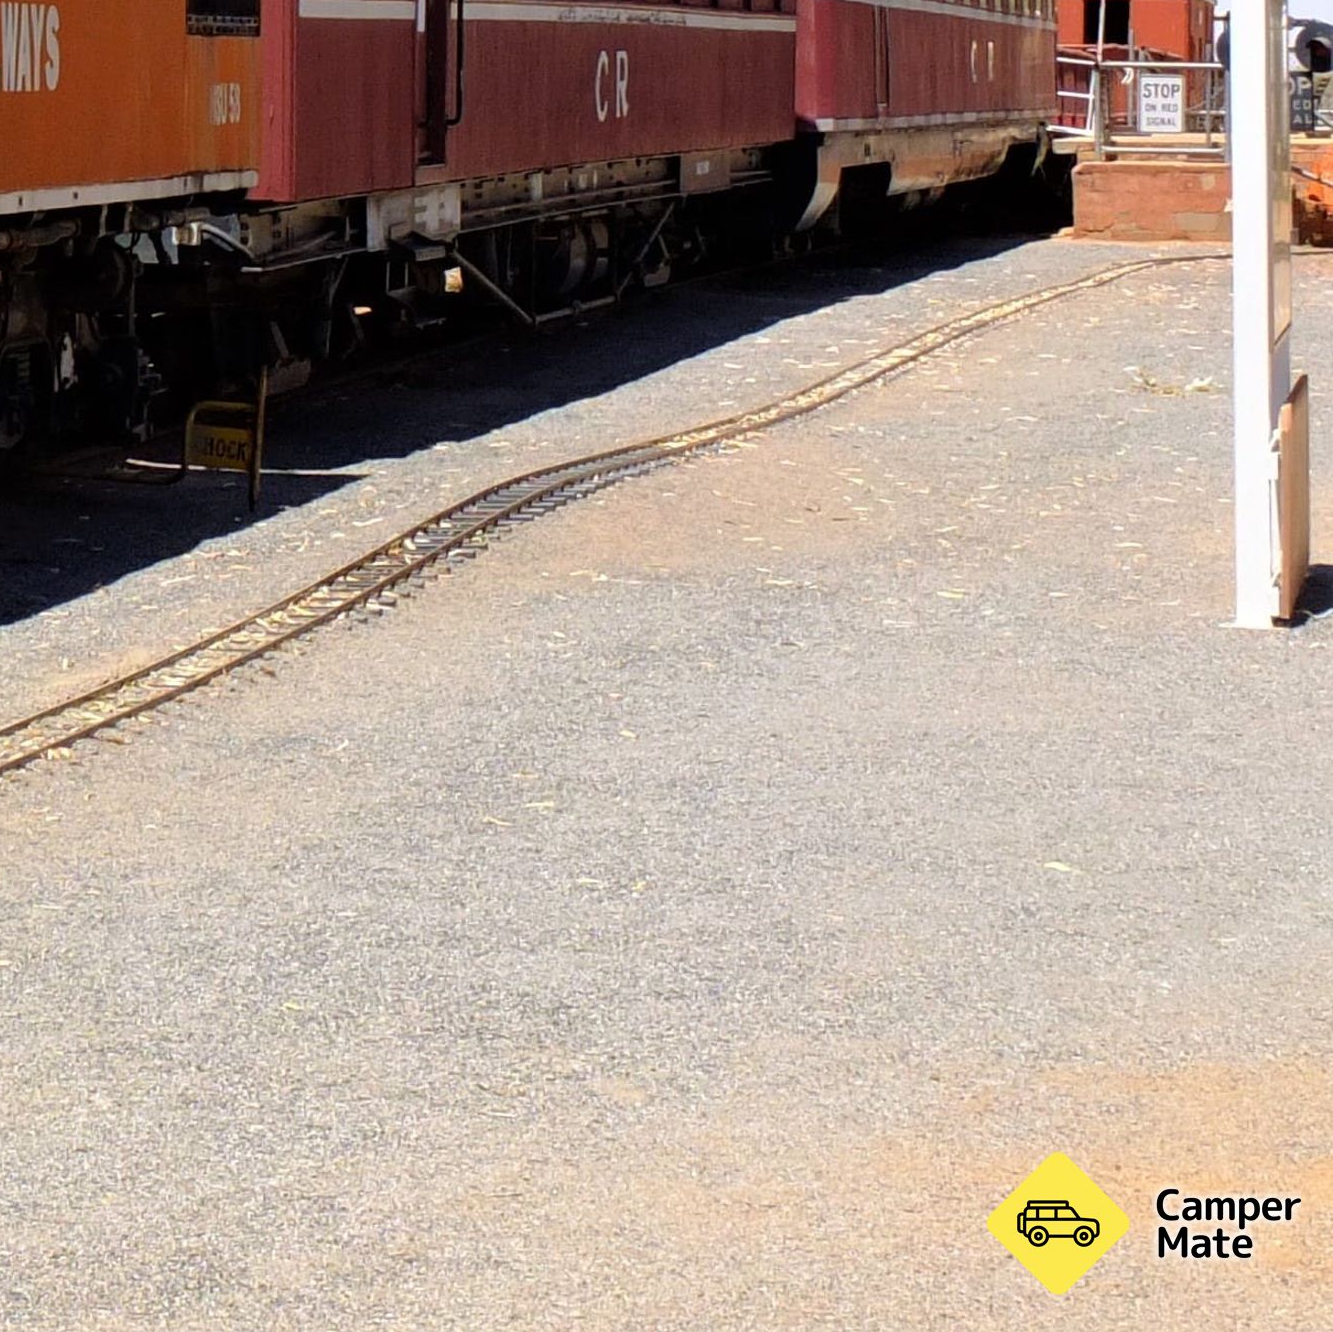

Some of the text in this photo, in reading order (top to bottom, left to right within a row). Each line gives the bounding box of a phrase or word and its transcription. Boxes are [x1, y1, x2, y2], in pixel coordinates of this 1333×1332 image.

[1143, 83, 1181, 98] STOP
[1144, 103, 1179, 113] ON RED
[1146, 117, 1176, 126] SIGNAL
